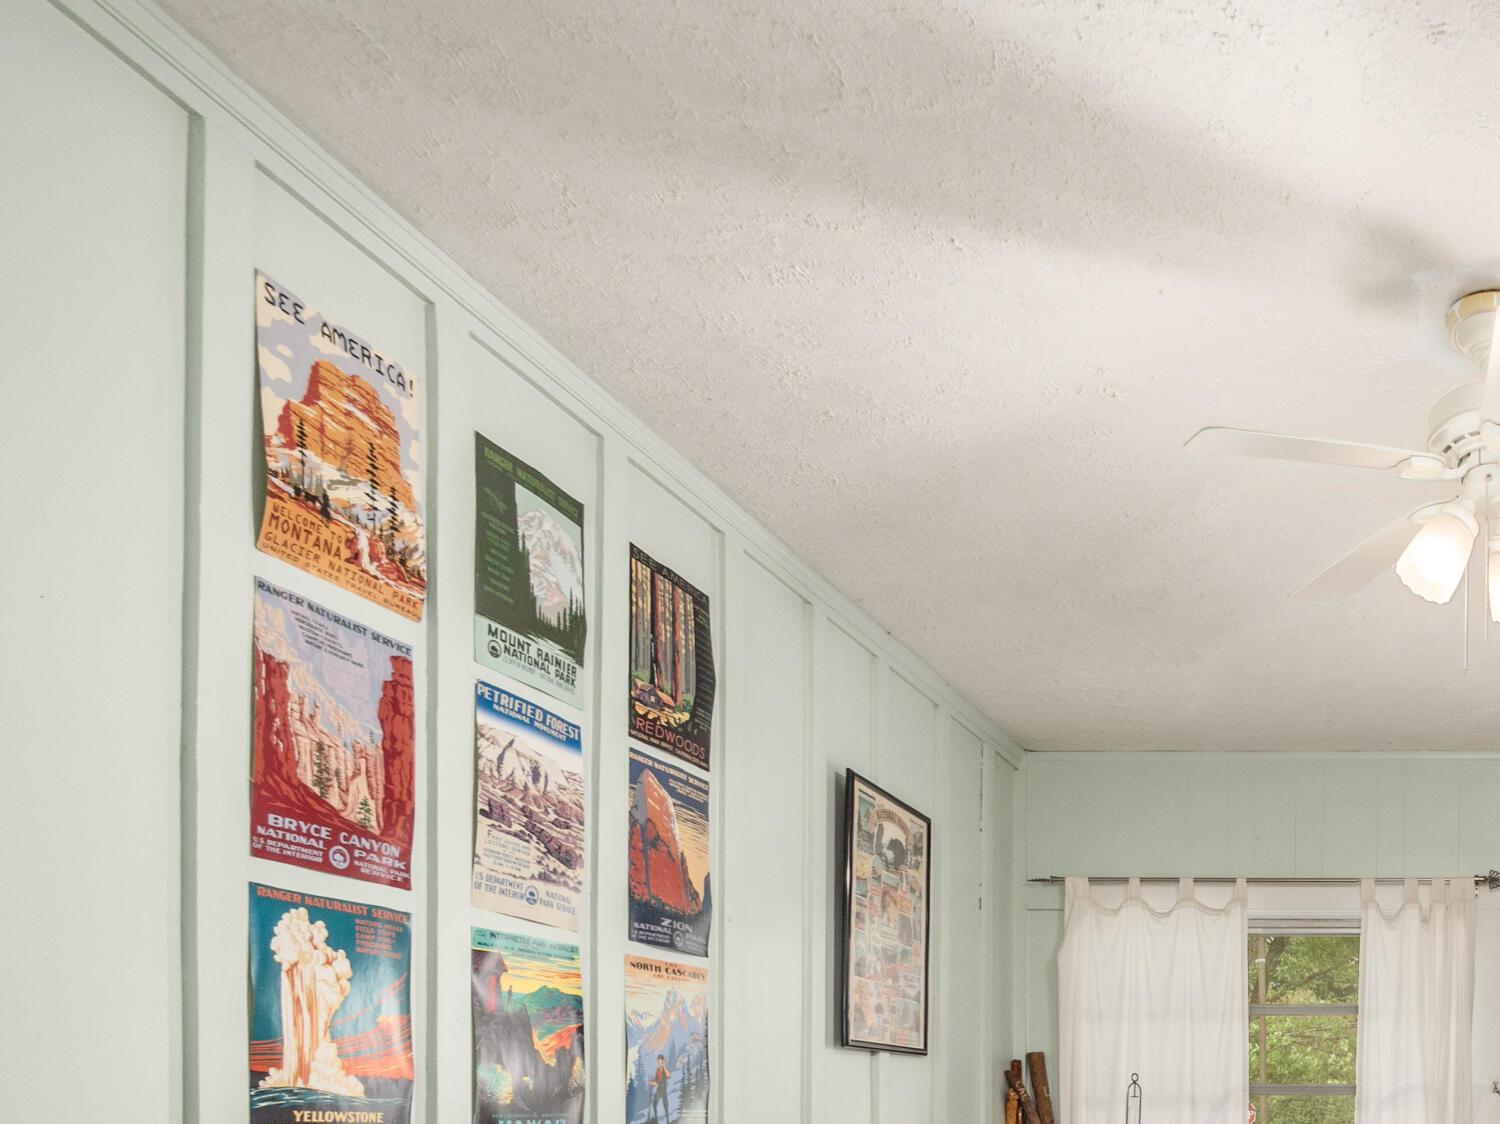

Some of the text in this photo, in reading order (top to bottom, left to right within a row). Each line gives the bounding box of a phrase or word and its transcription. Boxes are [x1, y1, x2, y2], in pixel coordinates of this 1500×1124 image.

[264, 282, 415, 399] SEE AMERICA!
[268, 512, 342, 561] MONTANA
[272, 503, 343, 544] WELCOME TO
[262, 543, 418, 617] UNITED STATES TRAVEL BUREAU
[264, 531, 419, 611] GLACIER NATIONAL PARK
[632, 548, 708, 604] SEE AMERICA
[257, 580, 305, 608] RANGER
[307, 602, 369, 637] NATURALIST
[371, 631, 414, 657] SERVICE
[487, 623, 531, 655] MOUNT
[536, 647, 577, 678] RAINIER
[503, 644, 551, 675] NATIONAL
[555, 669, 577, 689] PARK
[477, 683, 581, 740] PETRIFIED FOREST
[493, 703, 531, 724] NATIONAL
[636, 717, 706, 760] REDWOODS
[252, 842, 324, 863] OF THE INTERIOR
[256, 825, 408, 871] NATIONAL PARK
[266, 839, 324, 857] DEPARTMENT
[267, 813, 400, 858] BRYCE CANYON
[354, 860, 390, 874] NATIONAL
[360, 867, 404, 882] SERVICE
[485, 874, 524, 891] DEPARTMENT
[257, 886, 410, 925] RANGER NATURALIST SERVICE
[485, 883, 497, 894] THE
[539, 898, 554, 909] PARK
[634, 922, 672, 935] NATIONAL
[660, 917, 693, 933] ZION
[630, 961, 706, 981] NORTH CASCADES
[293, 1110, 384, 1123] YELLOWSTONE
